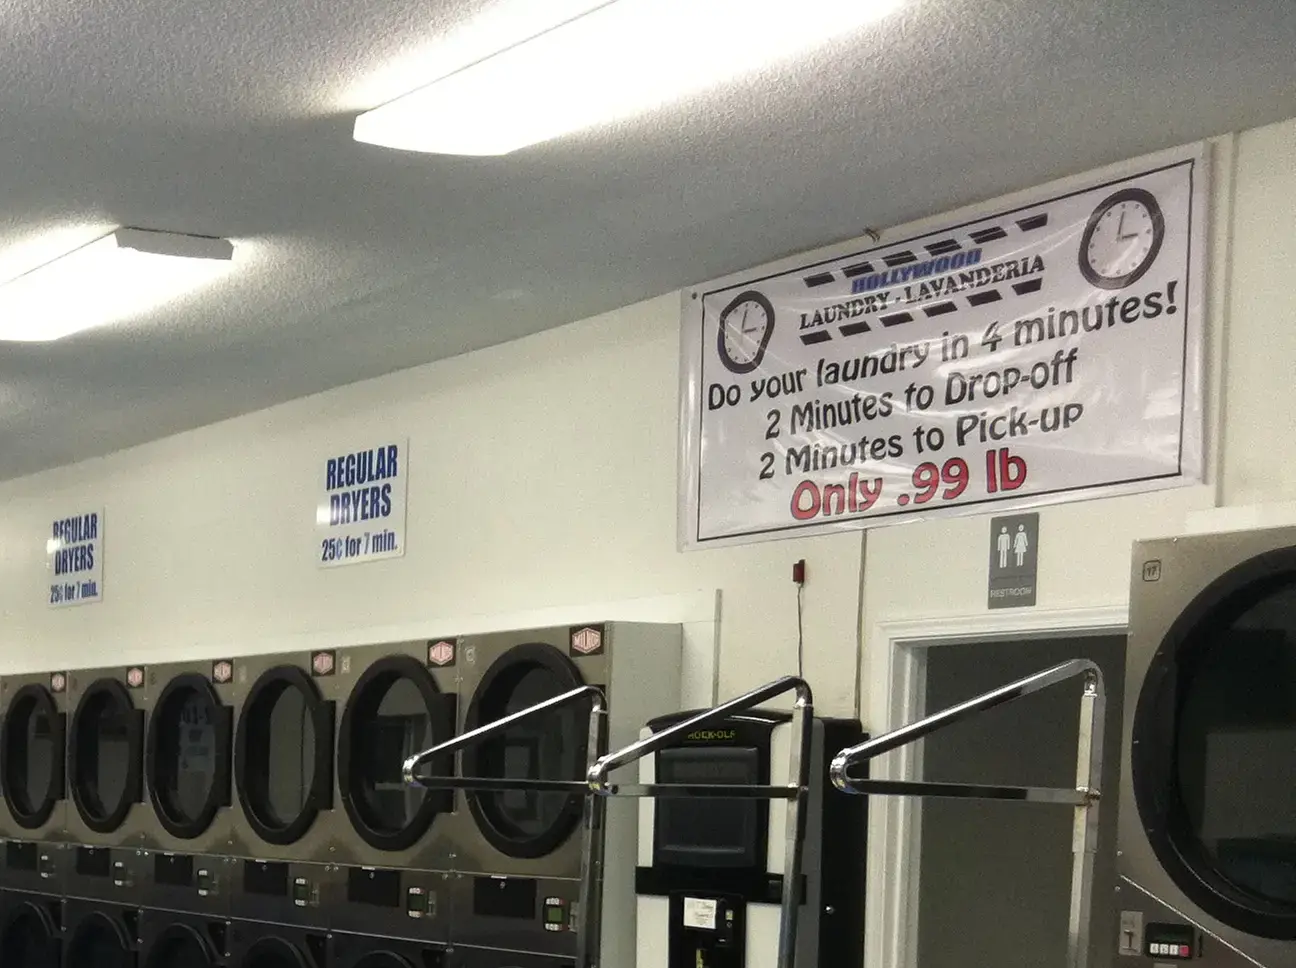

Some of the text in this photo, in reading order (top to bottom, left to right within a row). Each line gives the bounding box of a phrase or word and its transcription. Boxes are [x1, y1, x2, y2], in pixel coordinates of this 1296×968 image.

[799, 292, 891, 330] LAUNDRY
[904, 254, 1045, 304] LAVANDERIA
[852, 249, 982, 294] HOLLYWOOD
[708, 281, 1178, 410] Do your laundry in 4 minutes!
[765, 348, 1079, 440] 2 Minutes to Drop-off
[759, 402, 1084, 480] 2 Minutes to Pick-up
[326, 445, 398, 491] REGULAR
[790, 448, 1027, 520] Only .99 lb
[330, 483, 392, 526] DRYERS
[53, 513, 98, 544] REGULAR
[322, 529, 398, 562] 25¢ for 7 min.
[55, 543, 94, 576] DRYERS
[65, 582, 75, 600] for
[76, 581, 81, 599] 7
